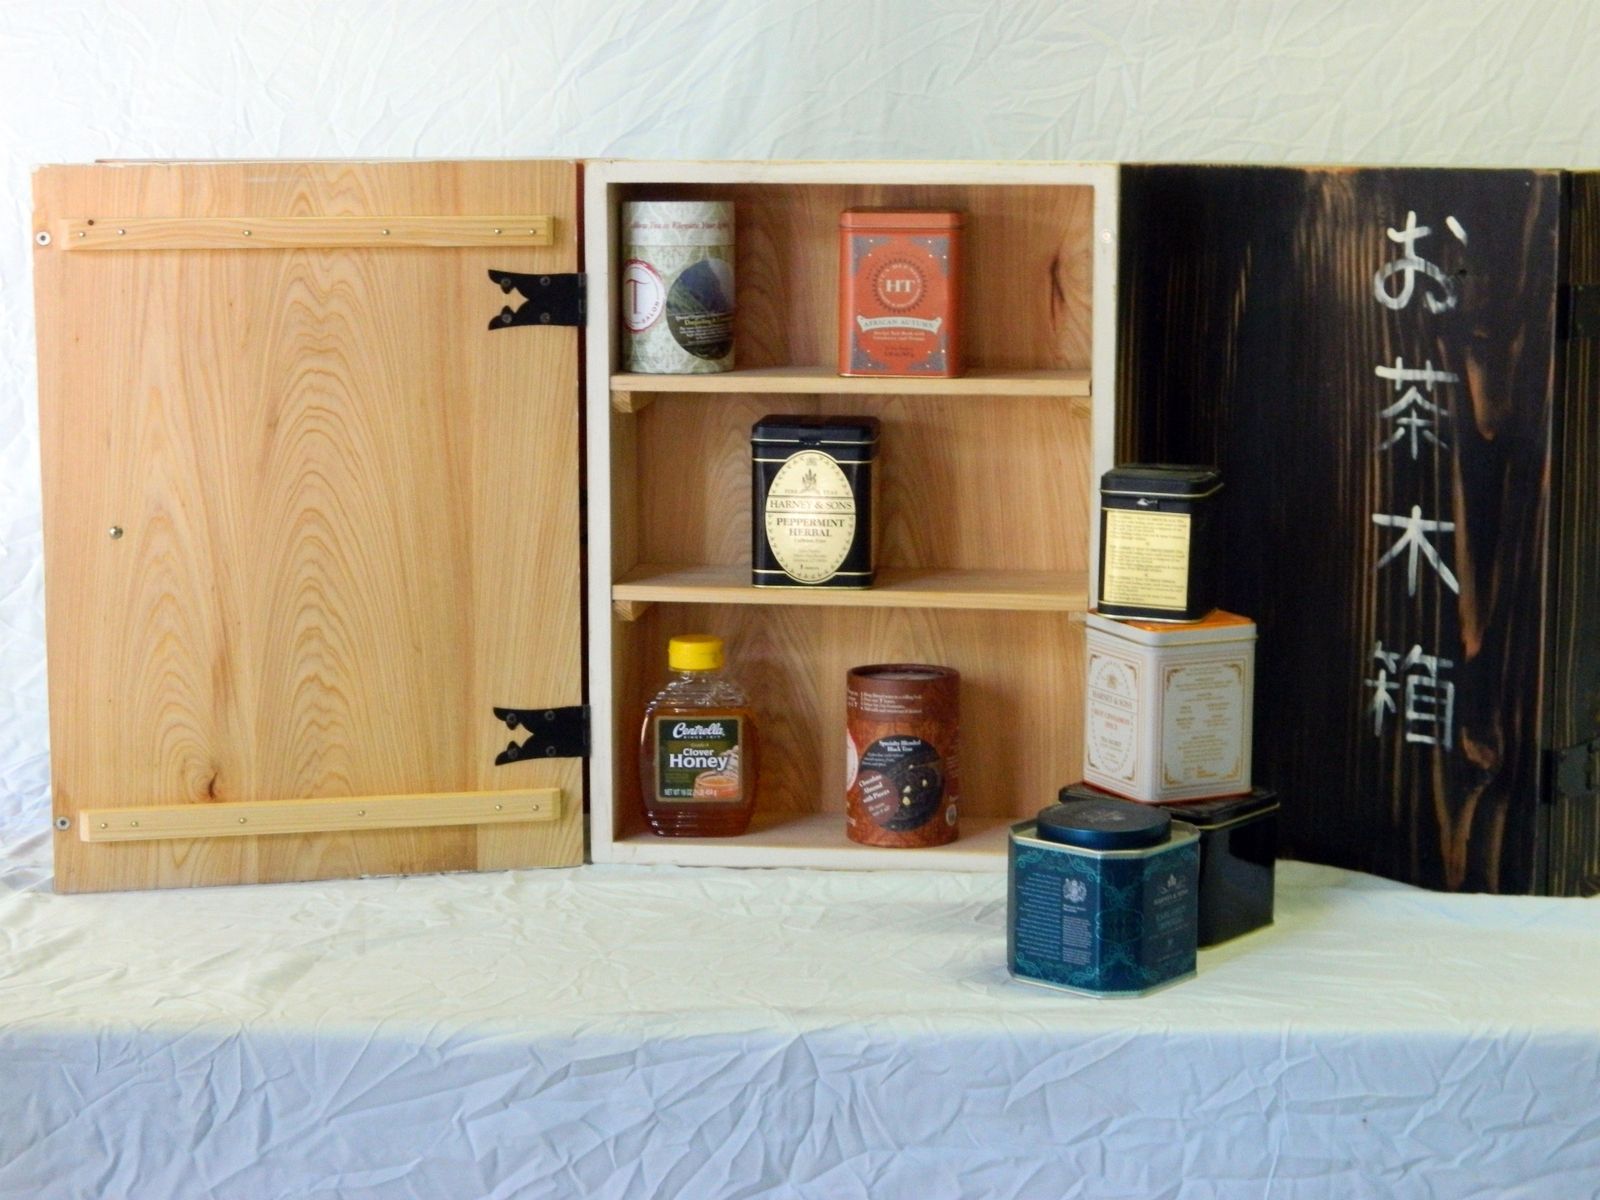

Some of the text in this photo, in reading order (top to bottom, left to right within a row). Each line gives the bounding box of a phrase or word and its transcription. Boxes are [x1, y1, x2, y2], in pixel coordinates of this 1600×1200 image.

[885, 279, 915, 293] HT
[863, 318, 898, 329] AFRICAN
[1364, 209, 1469, 752] お茶木箱
[770, 499, 852, 510] HARNEY & SONS
[776, 517, 845, 528] PEPPERMINT
[789, 527, 832, 538] HERBAL
[672, 722, 725, 739] Centrella
[683, 748, 714, 756] Clover
[669, 753, 728, 771] Honey
